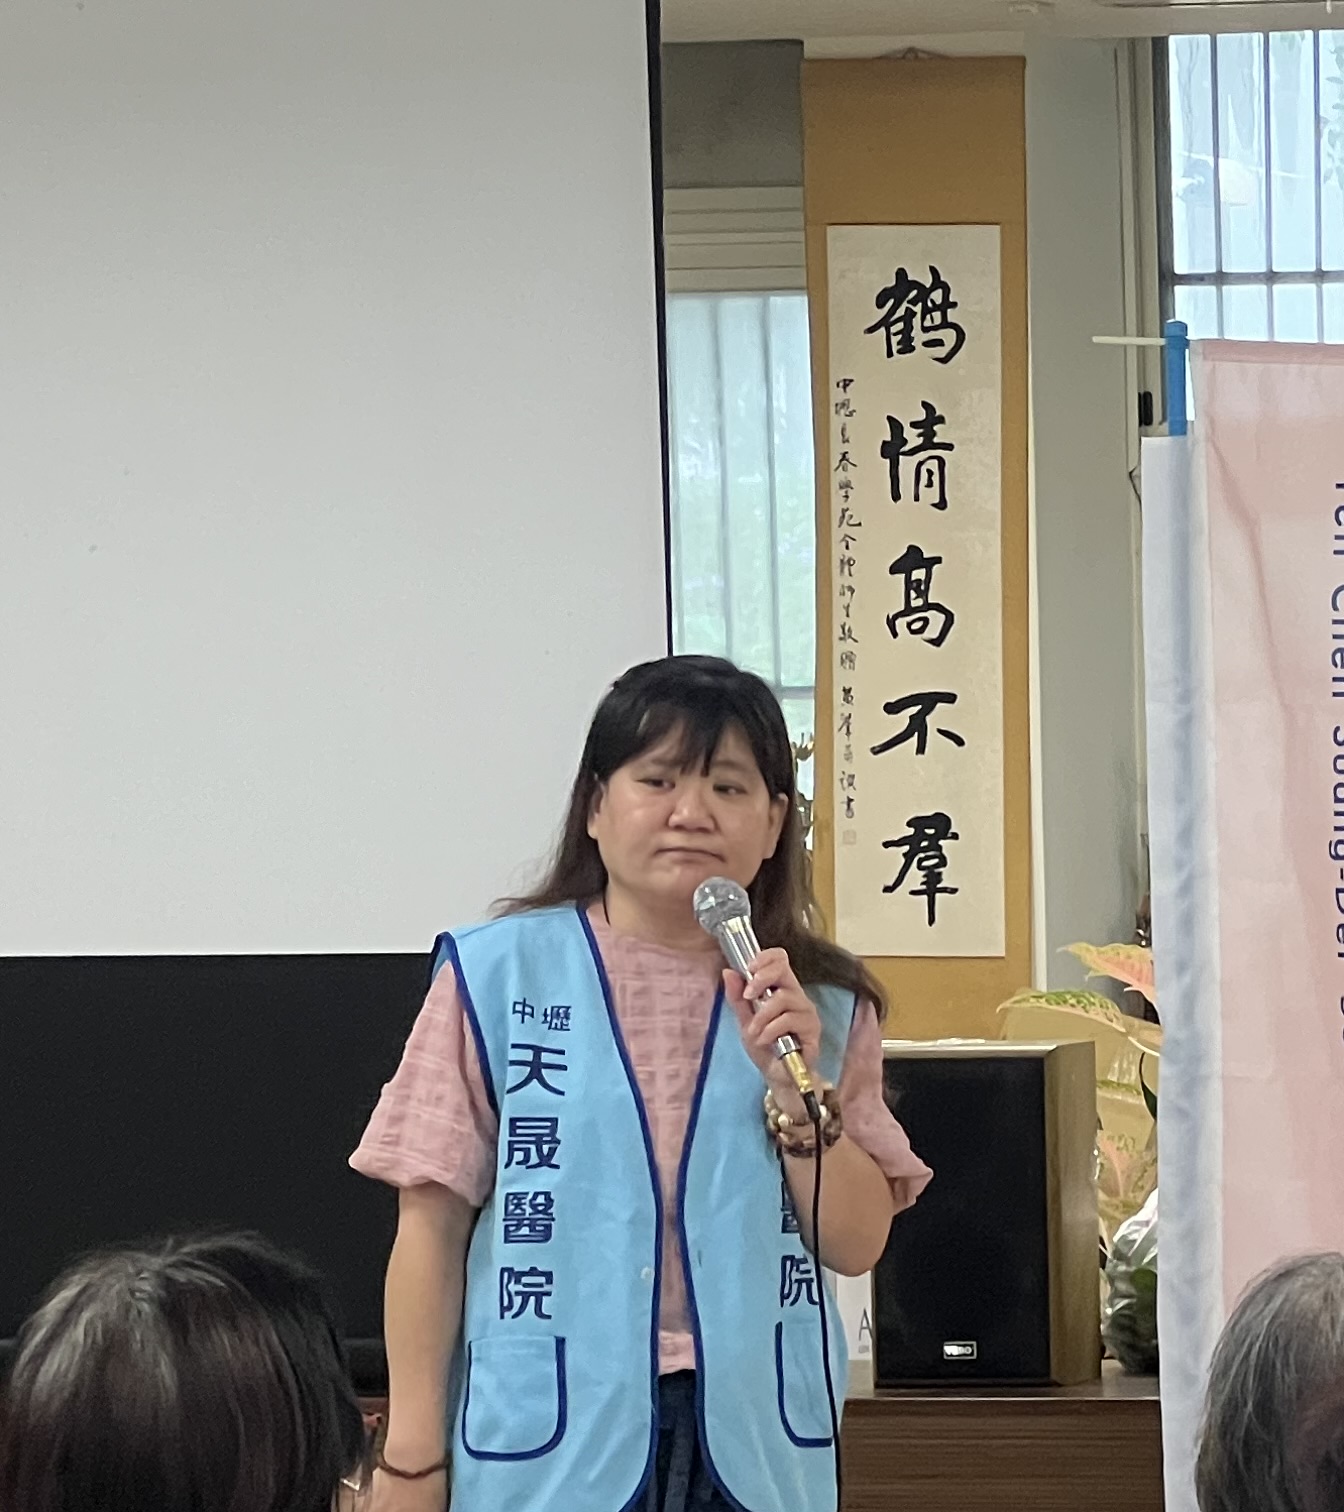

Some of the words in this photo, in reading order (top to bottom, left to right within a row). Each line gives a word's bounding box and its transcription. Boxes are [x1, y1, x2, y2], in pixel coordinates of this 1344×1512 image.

[511, 997, 572, 1032] 中壢
[499, 1042, 569, 1321] 天晟醫院
